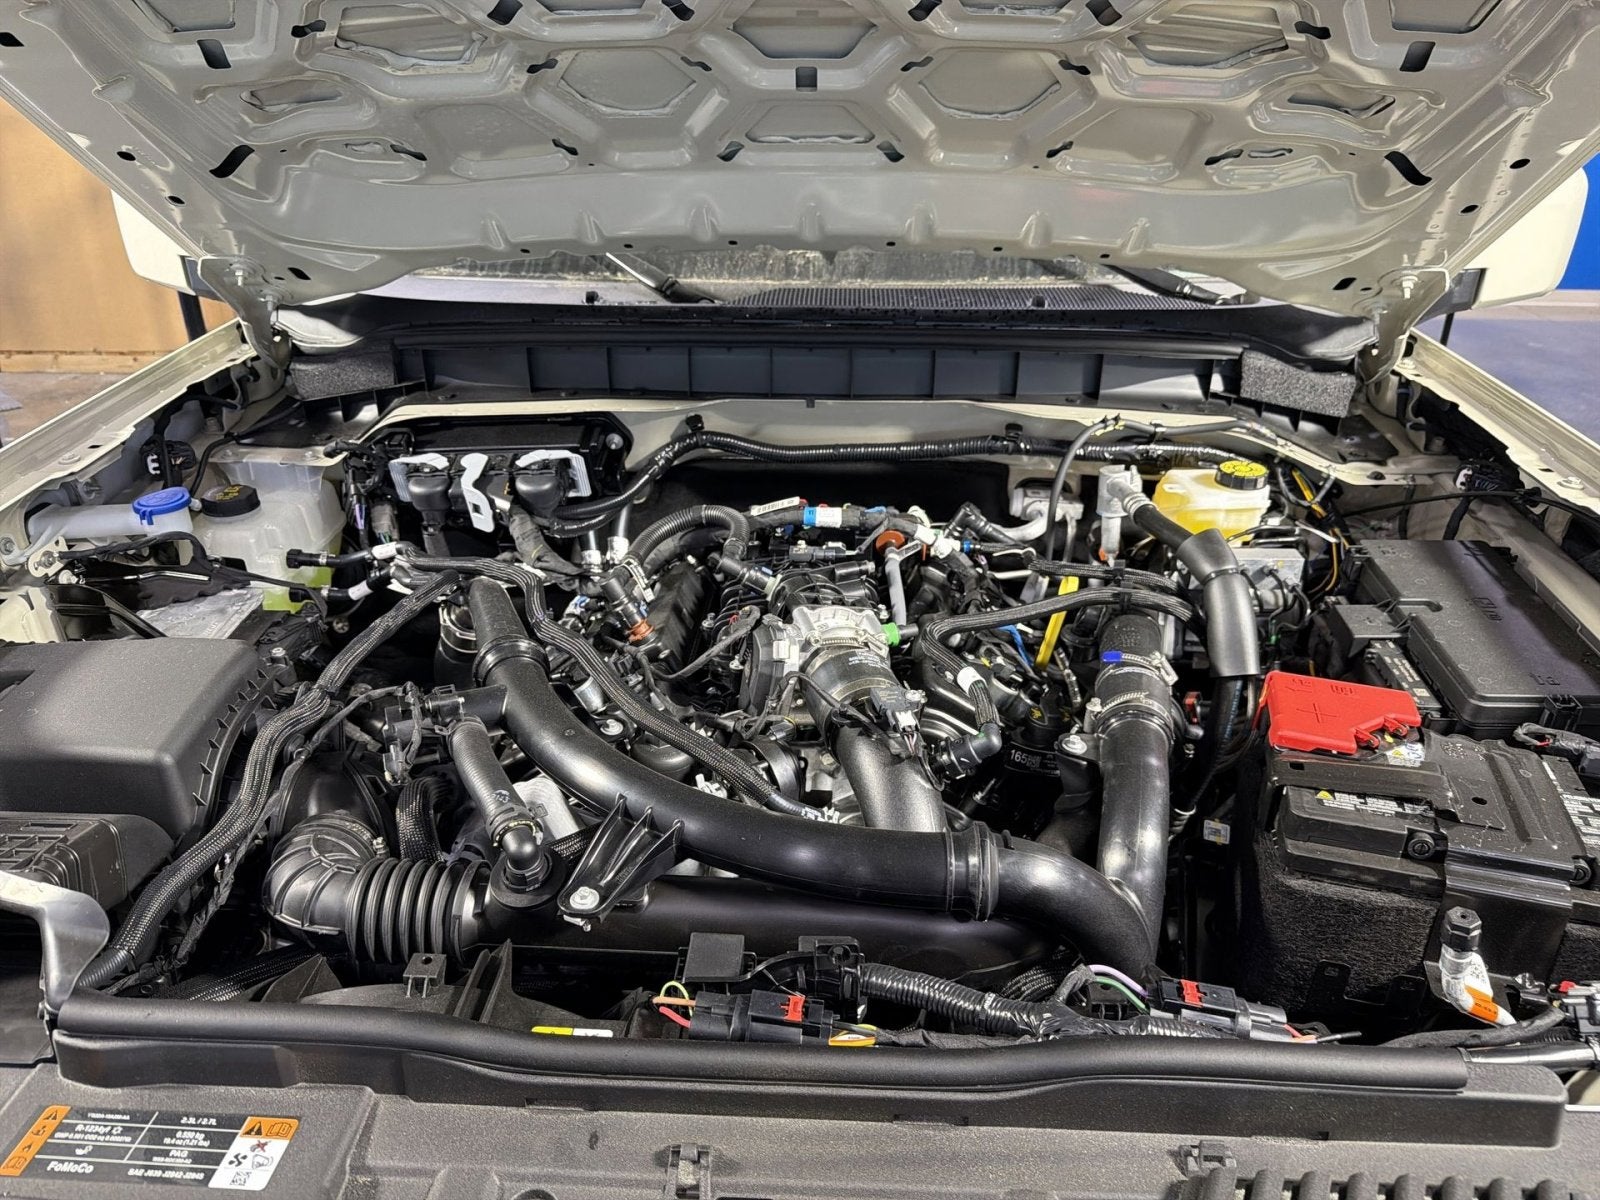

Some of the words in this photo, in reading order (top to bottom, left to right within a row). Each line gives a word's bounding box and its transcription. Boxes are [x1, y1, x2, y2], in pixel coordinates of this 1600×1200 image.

[180, 1116, 197, 1125] 2.3L
[201, 1117, 217, 1126] 2.7L
[168, 1149, 188, 1158] PAG
[46, 1161, 94, 1174] FoMoCo
[127, 1168, 144, 1176] SAE
